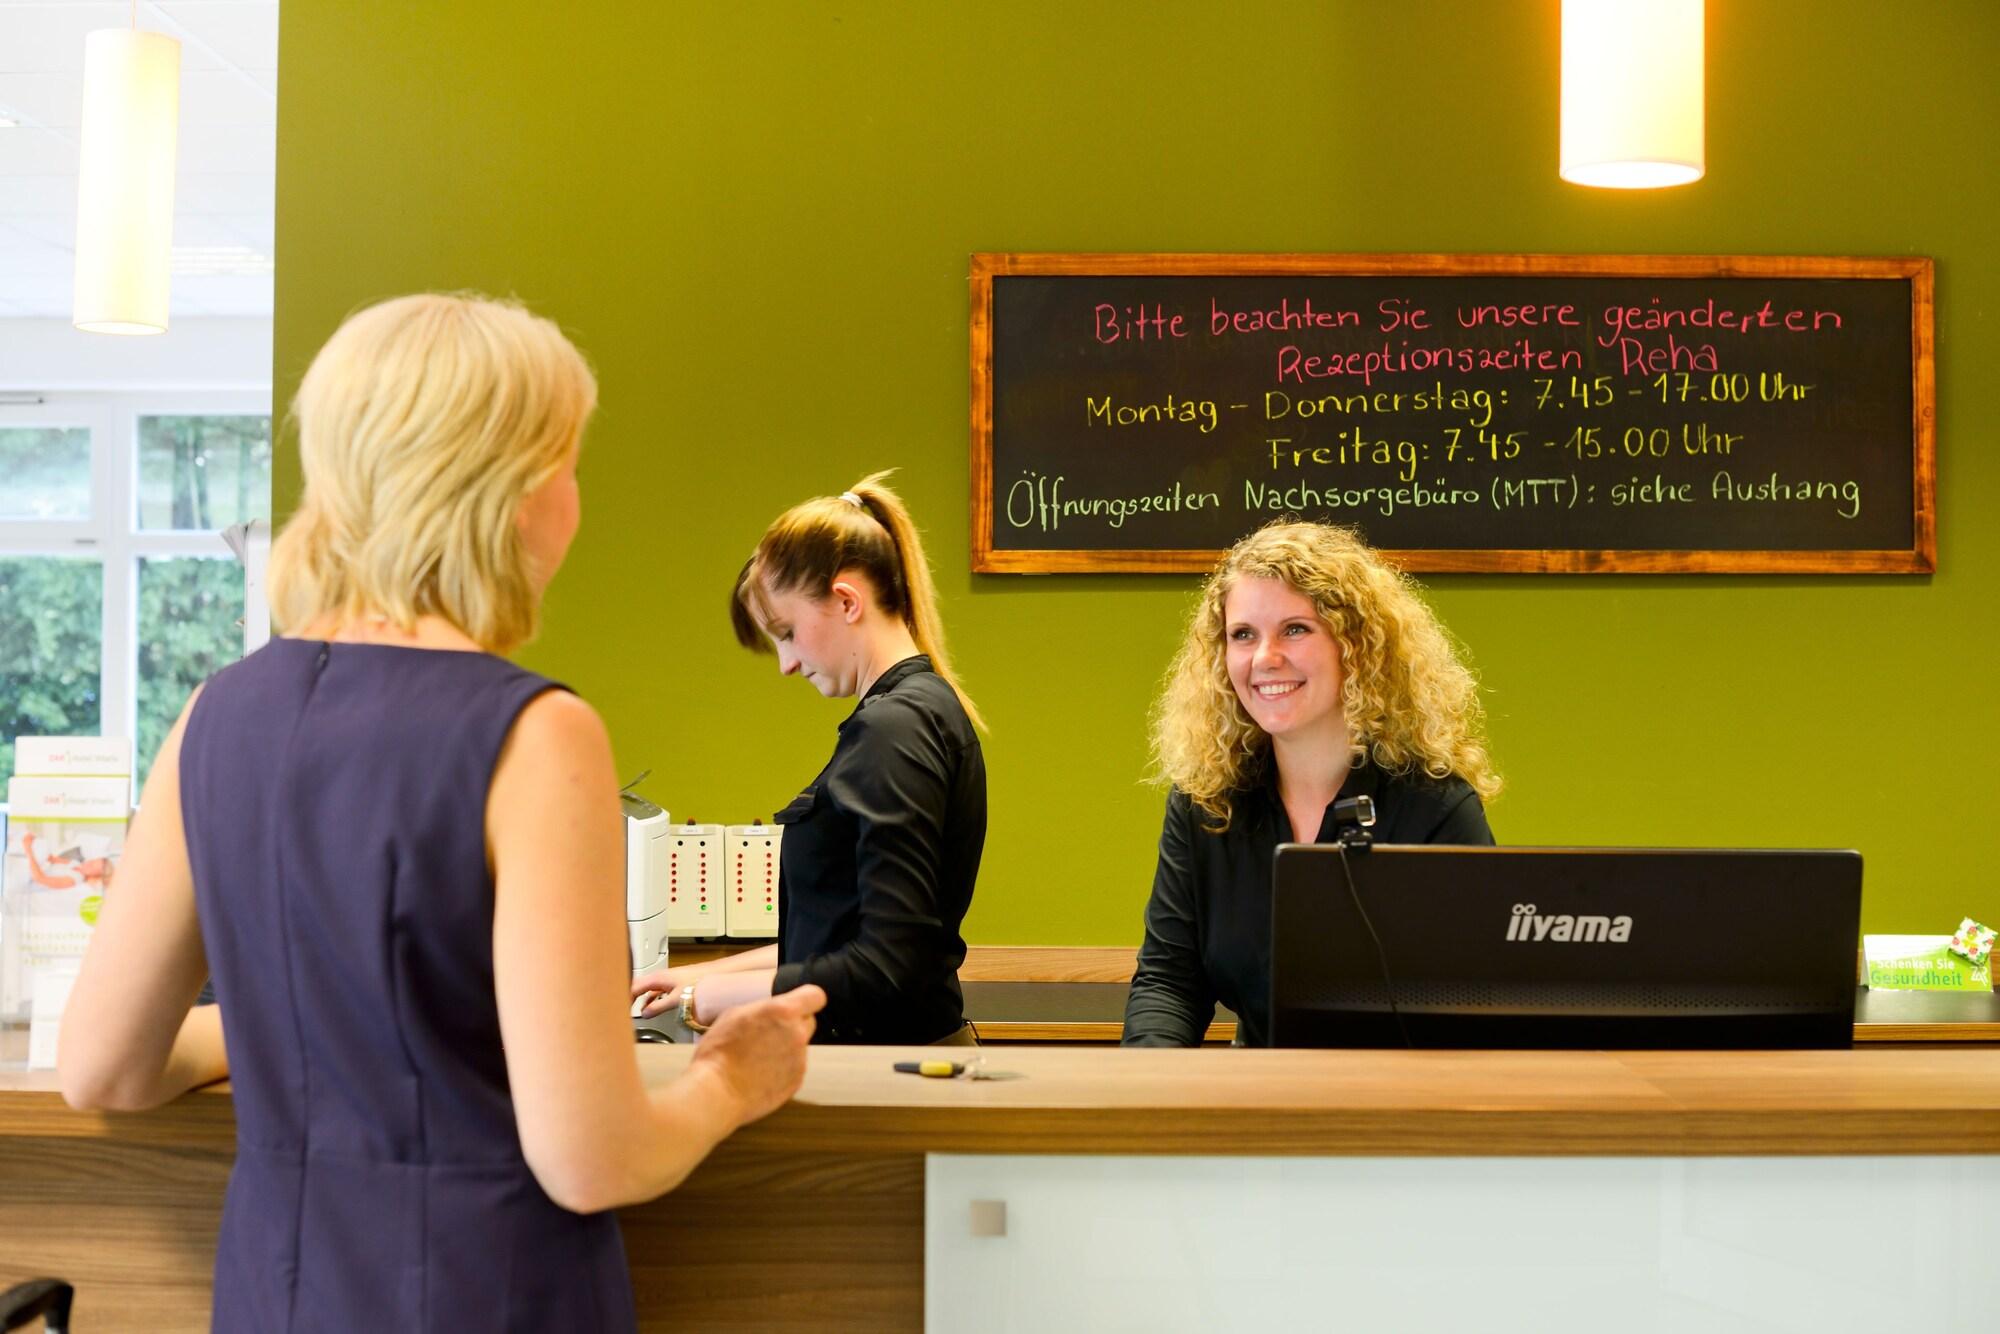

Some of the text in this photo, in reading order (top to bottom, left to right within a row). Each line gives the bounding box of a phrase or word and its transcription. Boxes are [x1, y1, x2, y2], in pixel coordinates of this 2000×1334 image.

[1095, 297, 1842, 348] Bitte beachten Sie unsere geänderten
[1277, 332, 1718, 387] Rezeptionszeiten Reha
[1086, 394, 1218, 434] Montag
[1264, 380, 1509, 428] Donnerstag:
[1533, 375, 1614, 410] 7.45
[1652, 371, 1750, 403] 17.00
[1759, 371, 1816, 402] Uhr
[1265, 426, 1429, 482] Freitag:
[1443, 428, 1529, 462] 7.45
[1564, 426, 1670, 460] 15.00
[1683, 423, 1745, 456] Uhr
[1006, 469, 1220, 533] Öffnungszeiten
[1245, 477, 1480, 518] Nachsorgebüro
[1611, 474, 1696, 506] siehe
[1712, 470, 1861, 519] Aushang
[1505, 903, 1634, 943] iiyama
[1870, 970, 1963, 986] Gesundheit
[1936, 958, 1955, 970] Sie
